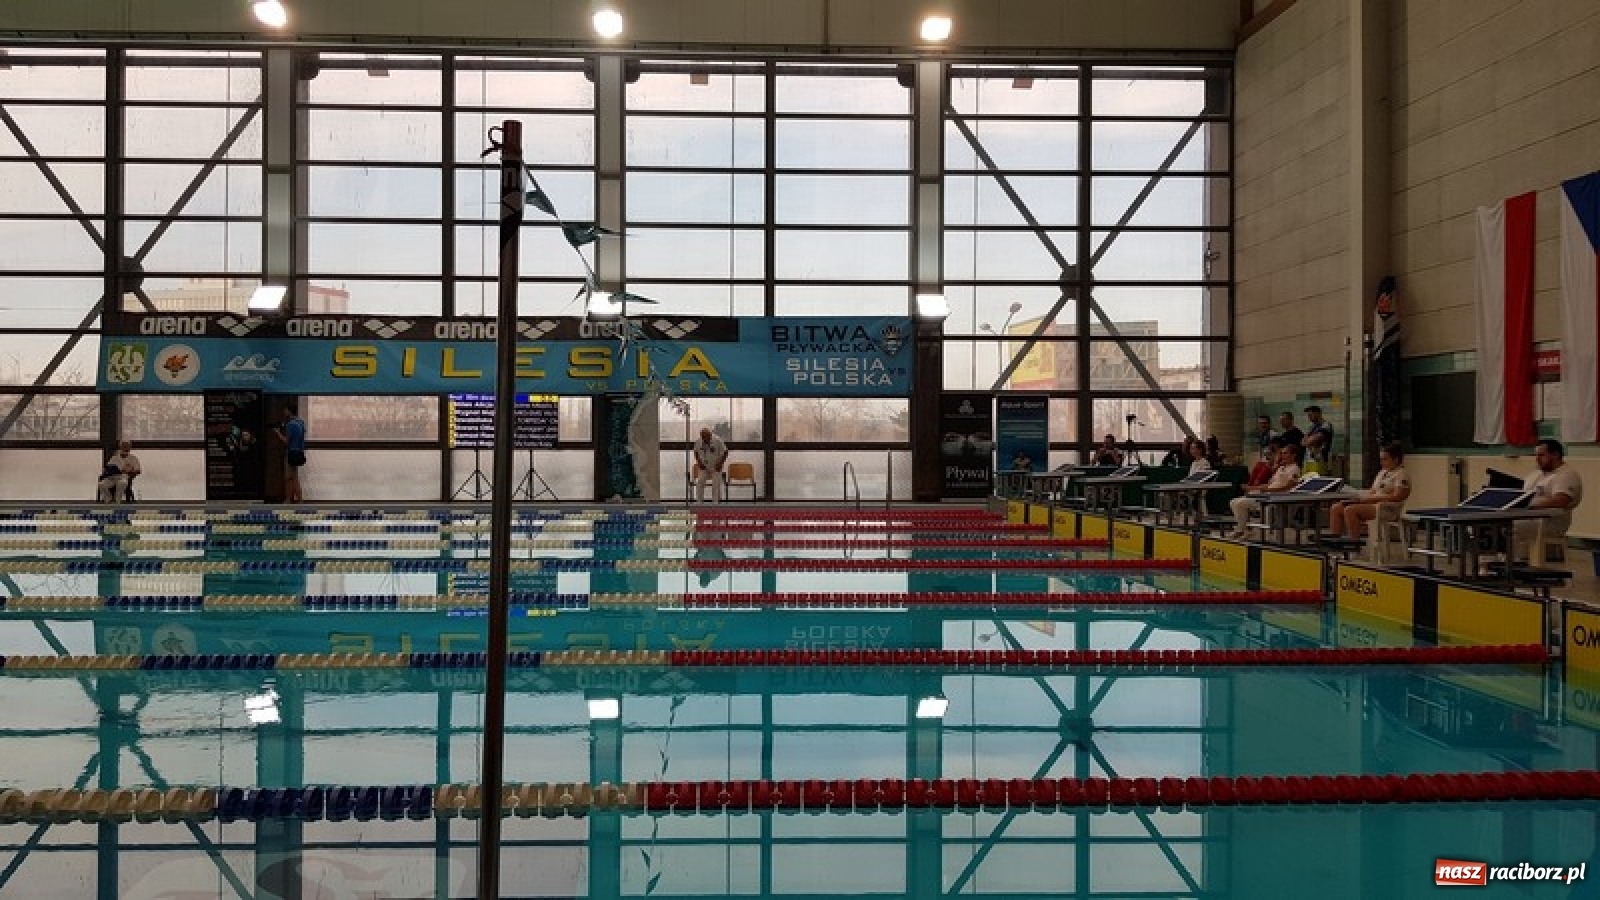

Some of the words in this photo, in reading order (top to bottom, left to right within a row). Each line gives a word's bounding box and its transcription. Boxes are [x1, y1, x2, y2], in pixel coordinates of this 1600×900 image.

[140, 317, 207, 335] arena
[286, 318, 353, 337] arena
[771, 325, 870, 342] BITWA
[332, 345, 720, 379] SILESIA
[786, 358, 885, 371] SILESIA
[793, 372, 893, 385] POLSKA
[1340, 575, 1379, 598] OMEGA
